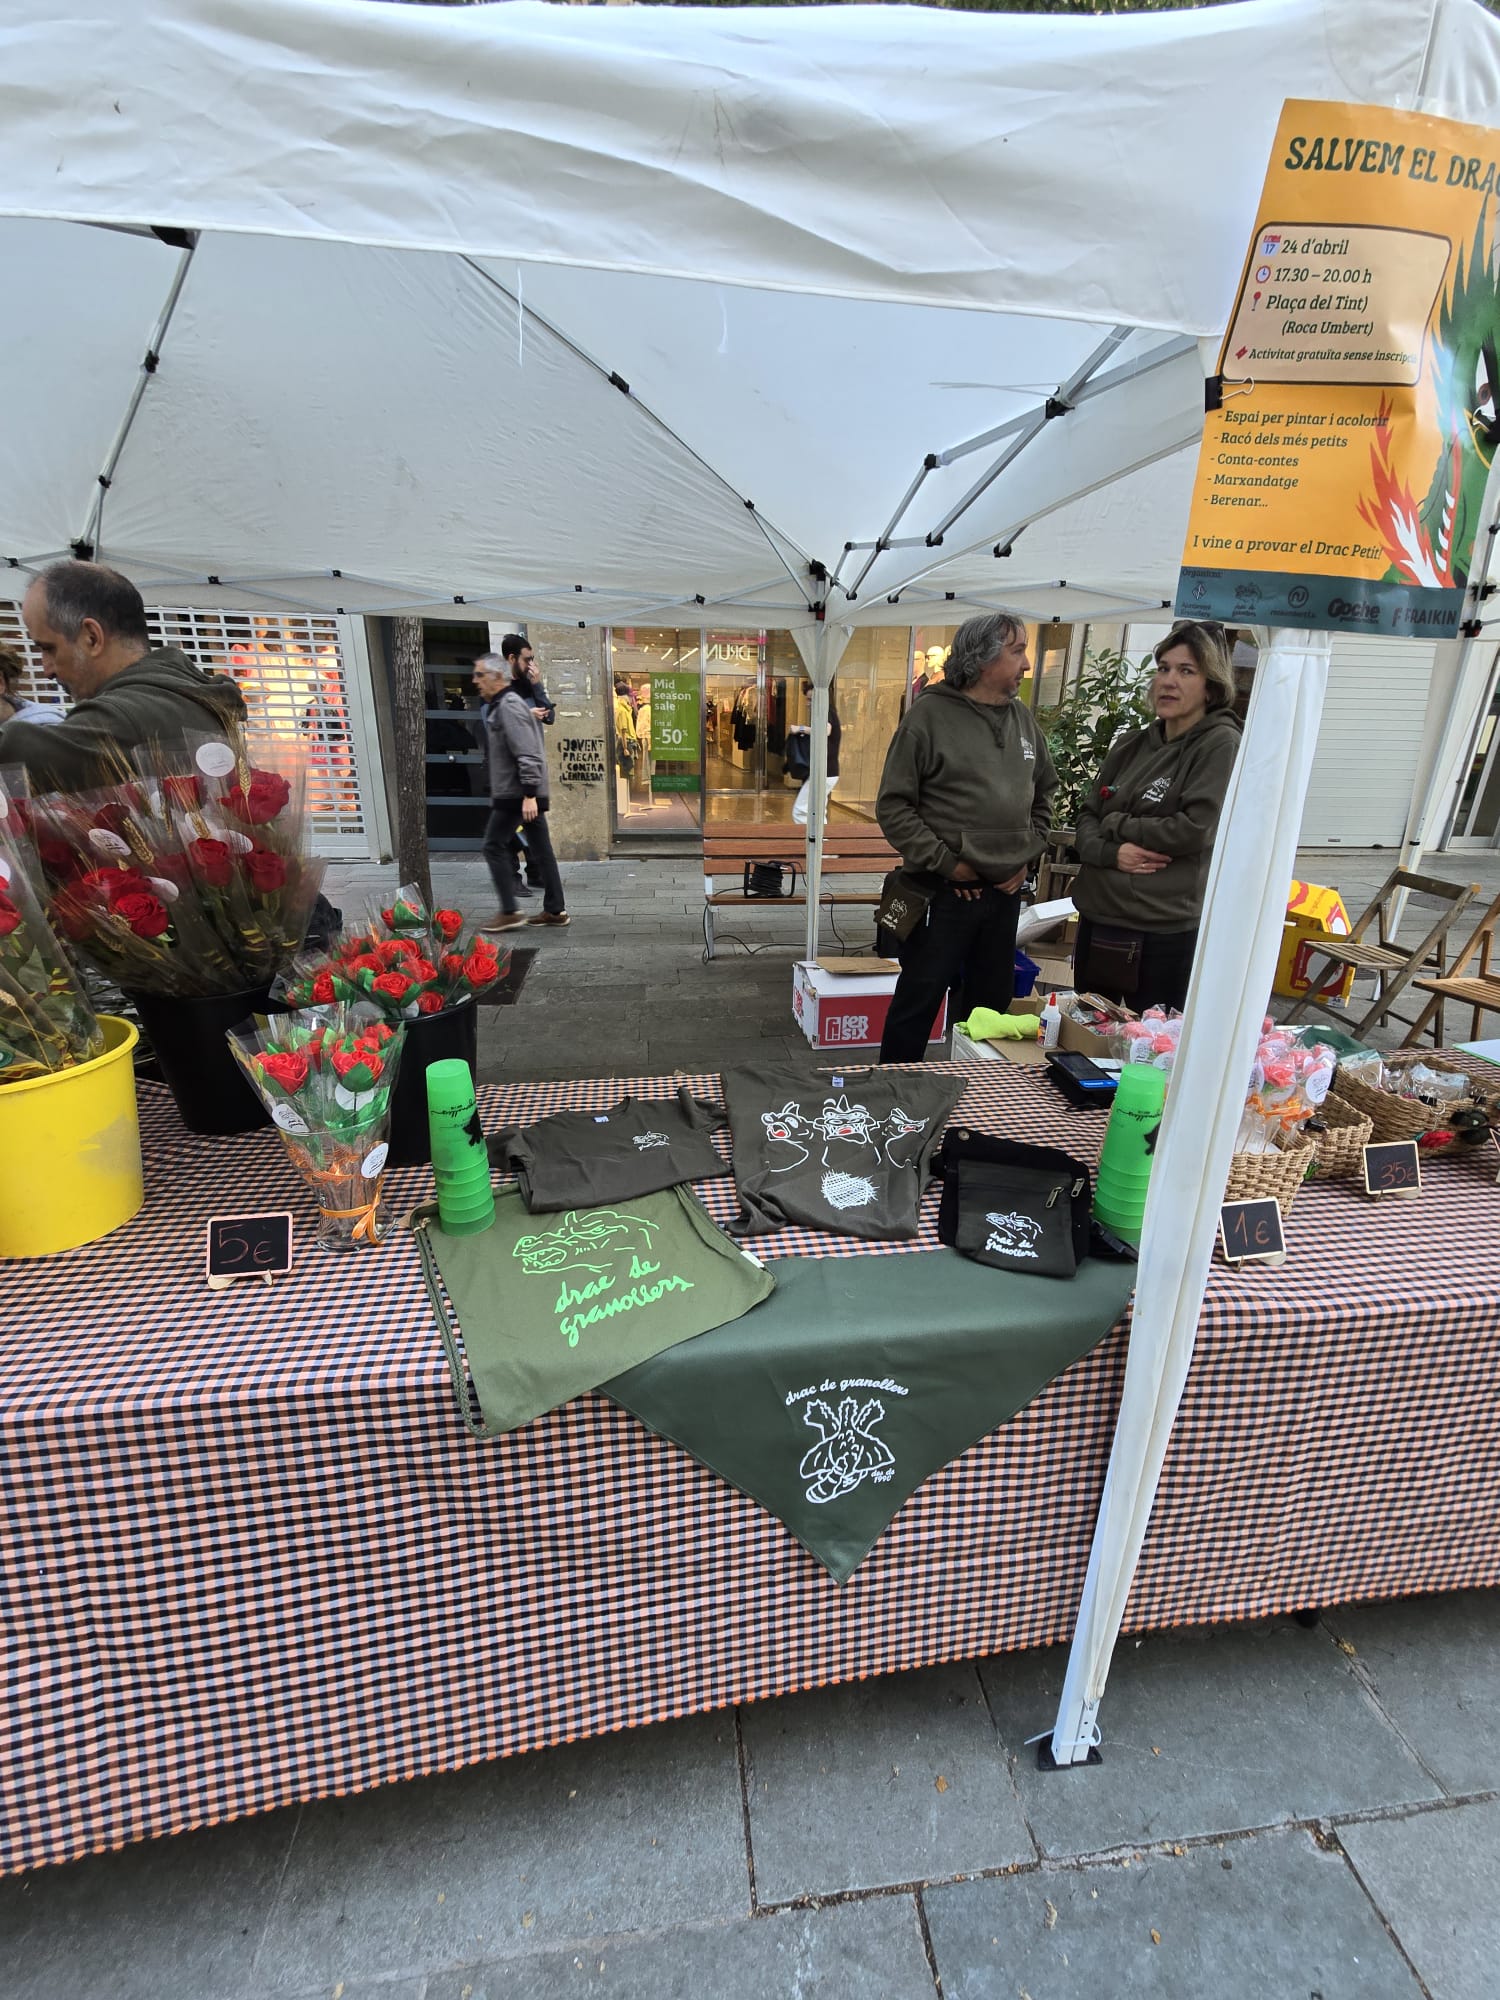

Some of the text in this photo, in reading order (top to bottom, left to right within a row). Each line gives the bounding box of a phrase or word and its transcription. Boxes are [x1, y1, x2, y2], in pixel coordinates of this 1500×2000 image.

[1284, 136, 1405, 176] SALVEM
[1408, 147, 1438, 183] EL
[1281, 238, 1349, 255] 24 d'abril
[1274, 267, 1309, 282] 17.30
[1322, 268, 1361, 283] 20.00
[1362, 268, 1372, 283] h
[1266, 294, 1368, 313] Plaça del Tint)
[1281, 320, 1374, 336] (Roca Umbert)
[1248, 348, 1296, 360] Activitat
[1296, 348, 1342, 362] gratuïta
[1343, 351, 1374, 361] sense
[1224, 410, 1260, 426] Espai
[1261, 414, 1284, 427] per
[1286, 412, 1327, 427] pintar
[1329, 412, 1335, 426] i
[1336, 413, 1389, 427] acolorir
[1220, 431, 1252, 445] Racó
[1254, 433, 1280, 446] dels
[1282, 432, 1308, 447] més
[1310, 434, 1348, 449] petits
[1217, 453, 1299, 467] Conta-contes
[1213, 473, 1299, 490] Marxandatge
[1210, 494, 1268, 508] Berenar...
[1193, 535, 1199, 547] I
[1202, 535, 1232, 549] vine
[1235, 539, 1244, 549] a
[1246, 538, 1298, 554] provar
[1299, 540, 1313, 554] el
[1315, 541, 1349, 557] Drac
[1405, 607, 1457, 625] FRAIKIN
[654, 678, 676, 689] Mid
[654, 692, 692, 701] season
[654, 701, 676, 711] sale
[567, 763, 604, 772] CONTRA
[554, 1255, 660, 1314] drac de
[559, 1275, 695, 1348] granollers
[785, 1378, 909, 1406] drac de granollers
